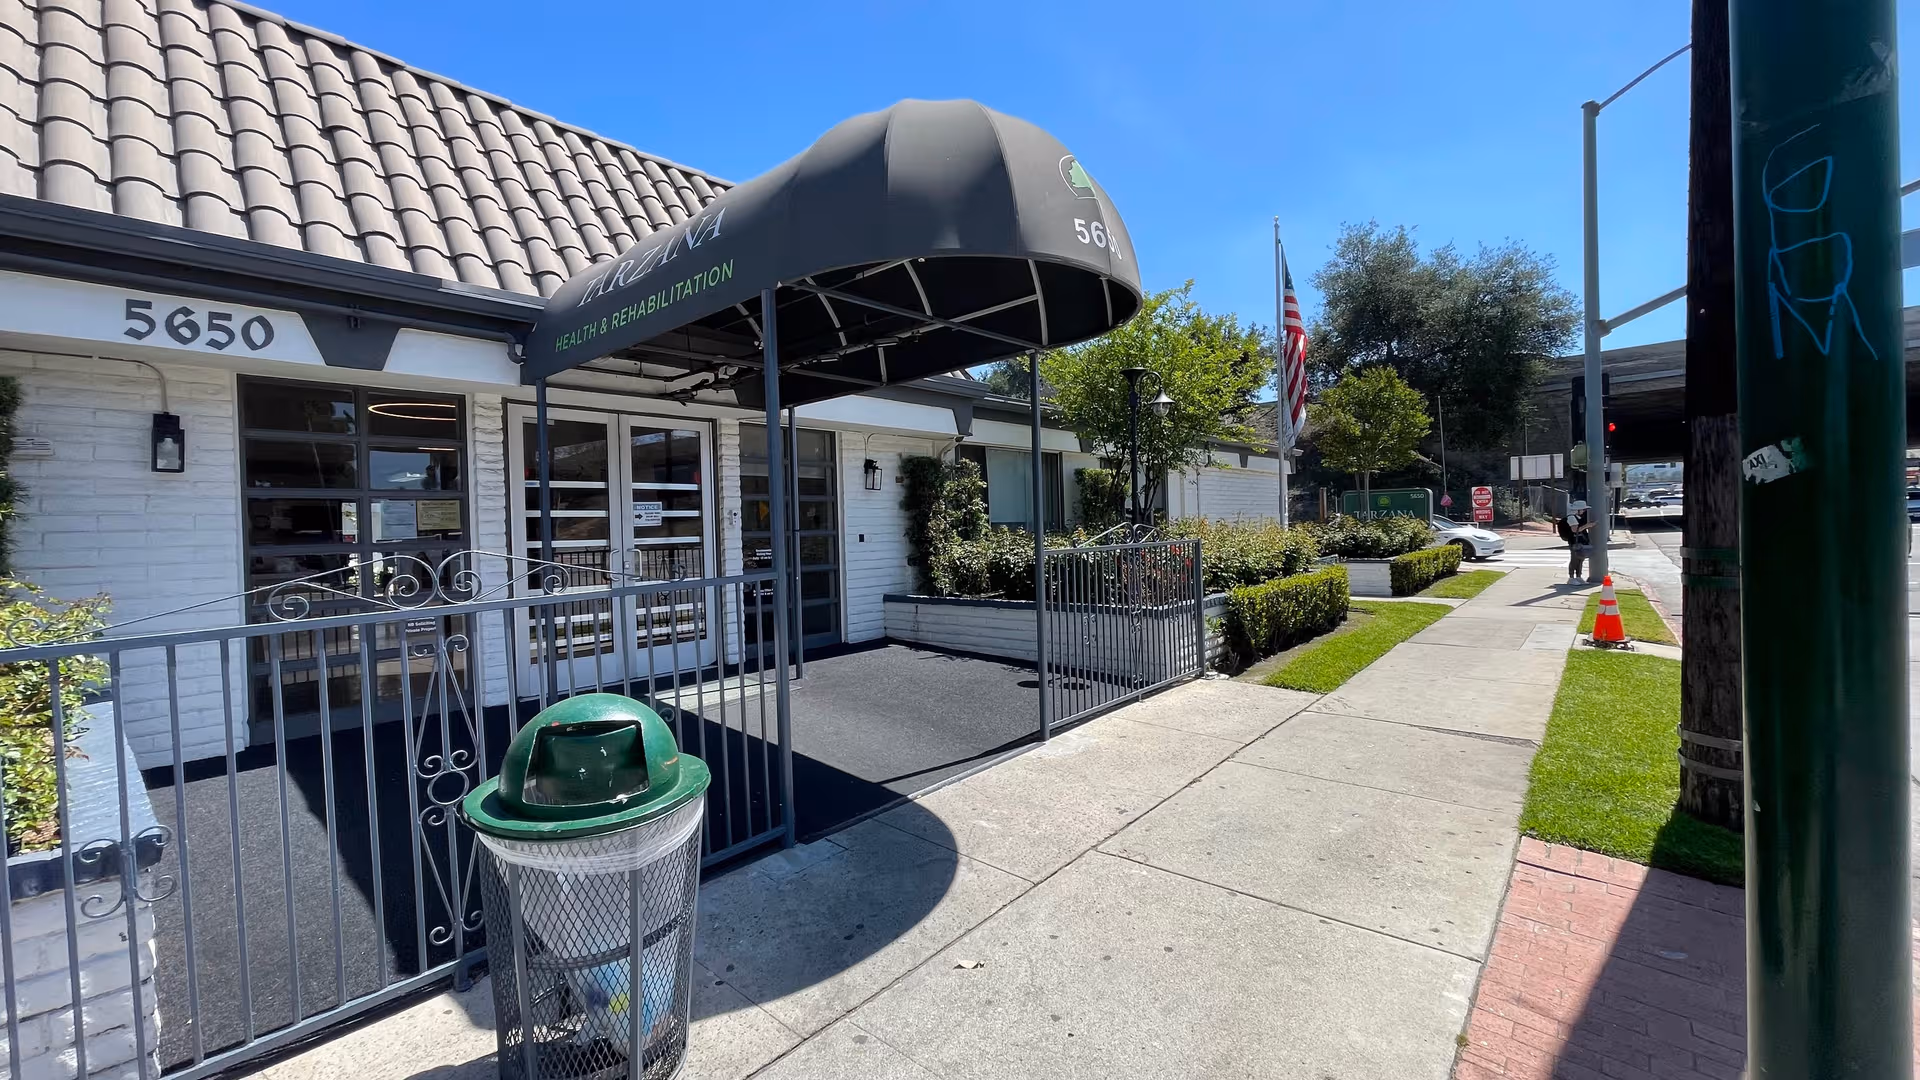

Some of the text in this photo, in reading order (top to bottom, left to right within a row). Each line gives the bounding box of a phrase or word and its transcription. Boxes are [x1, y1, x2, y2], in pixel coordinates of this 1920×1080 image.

[577, 207, 727, 308] TARZANA
[123, 298, 275, 351] 5650
[555, 259, 734, 352] HEALTH & REHABILITATION
